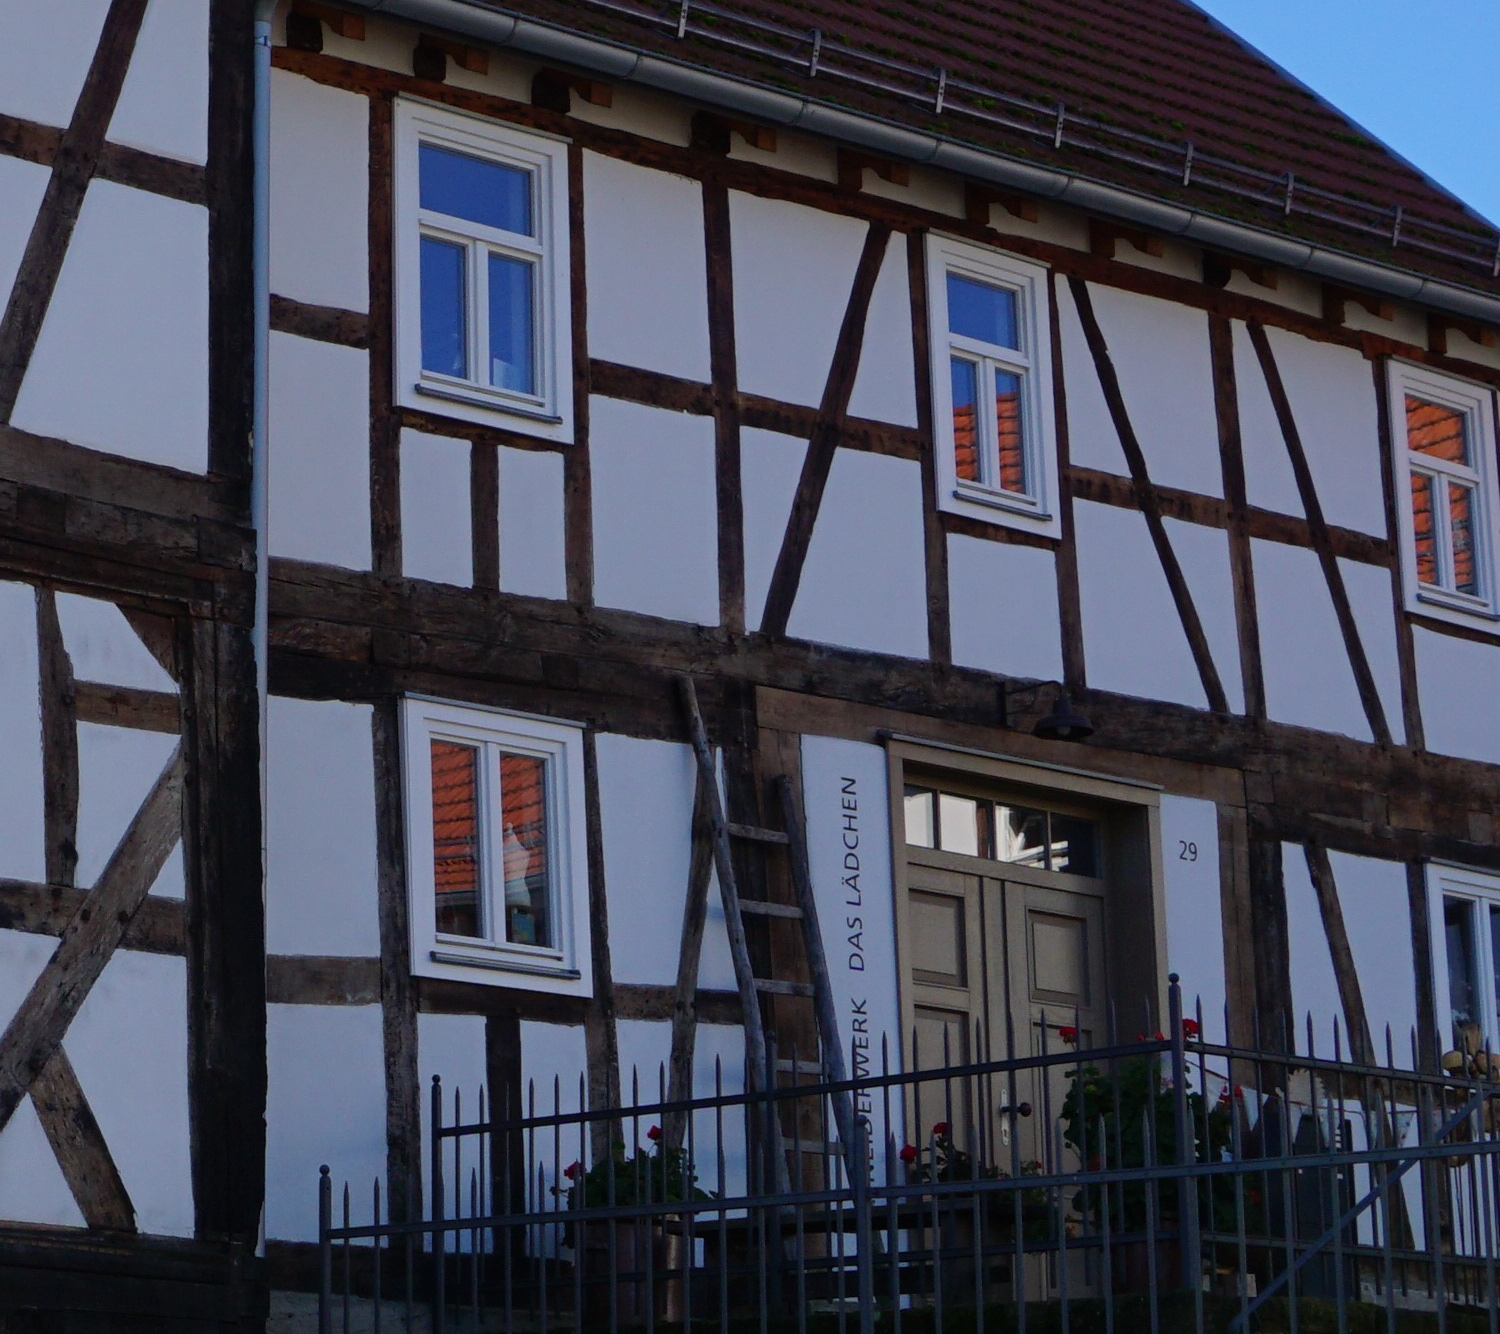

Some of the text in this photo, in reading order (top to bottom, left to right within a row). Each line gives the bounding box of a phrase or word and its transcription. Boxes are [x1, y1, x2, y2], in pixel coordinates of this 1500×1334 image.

[840, 776, 863, 907] LÄDCHEN
[1178, 840, 1198, 862] 29
[848, 916, 866, 972] DAS
